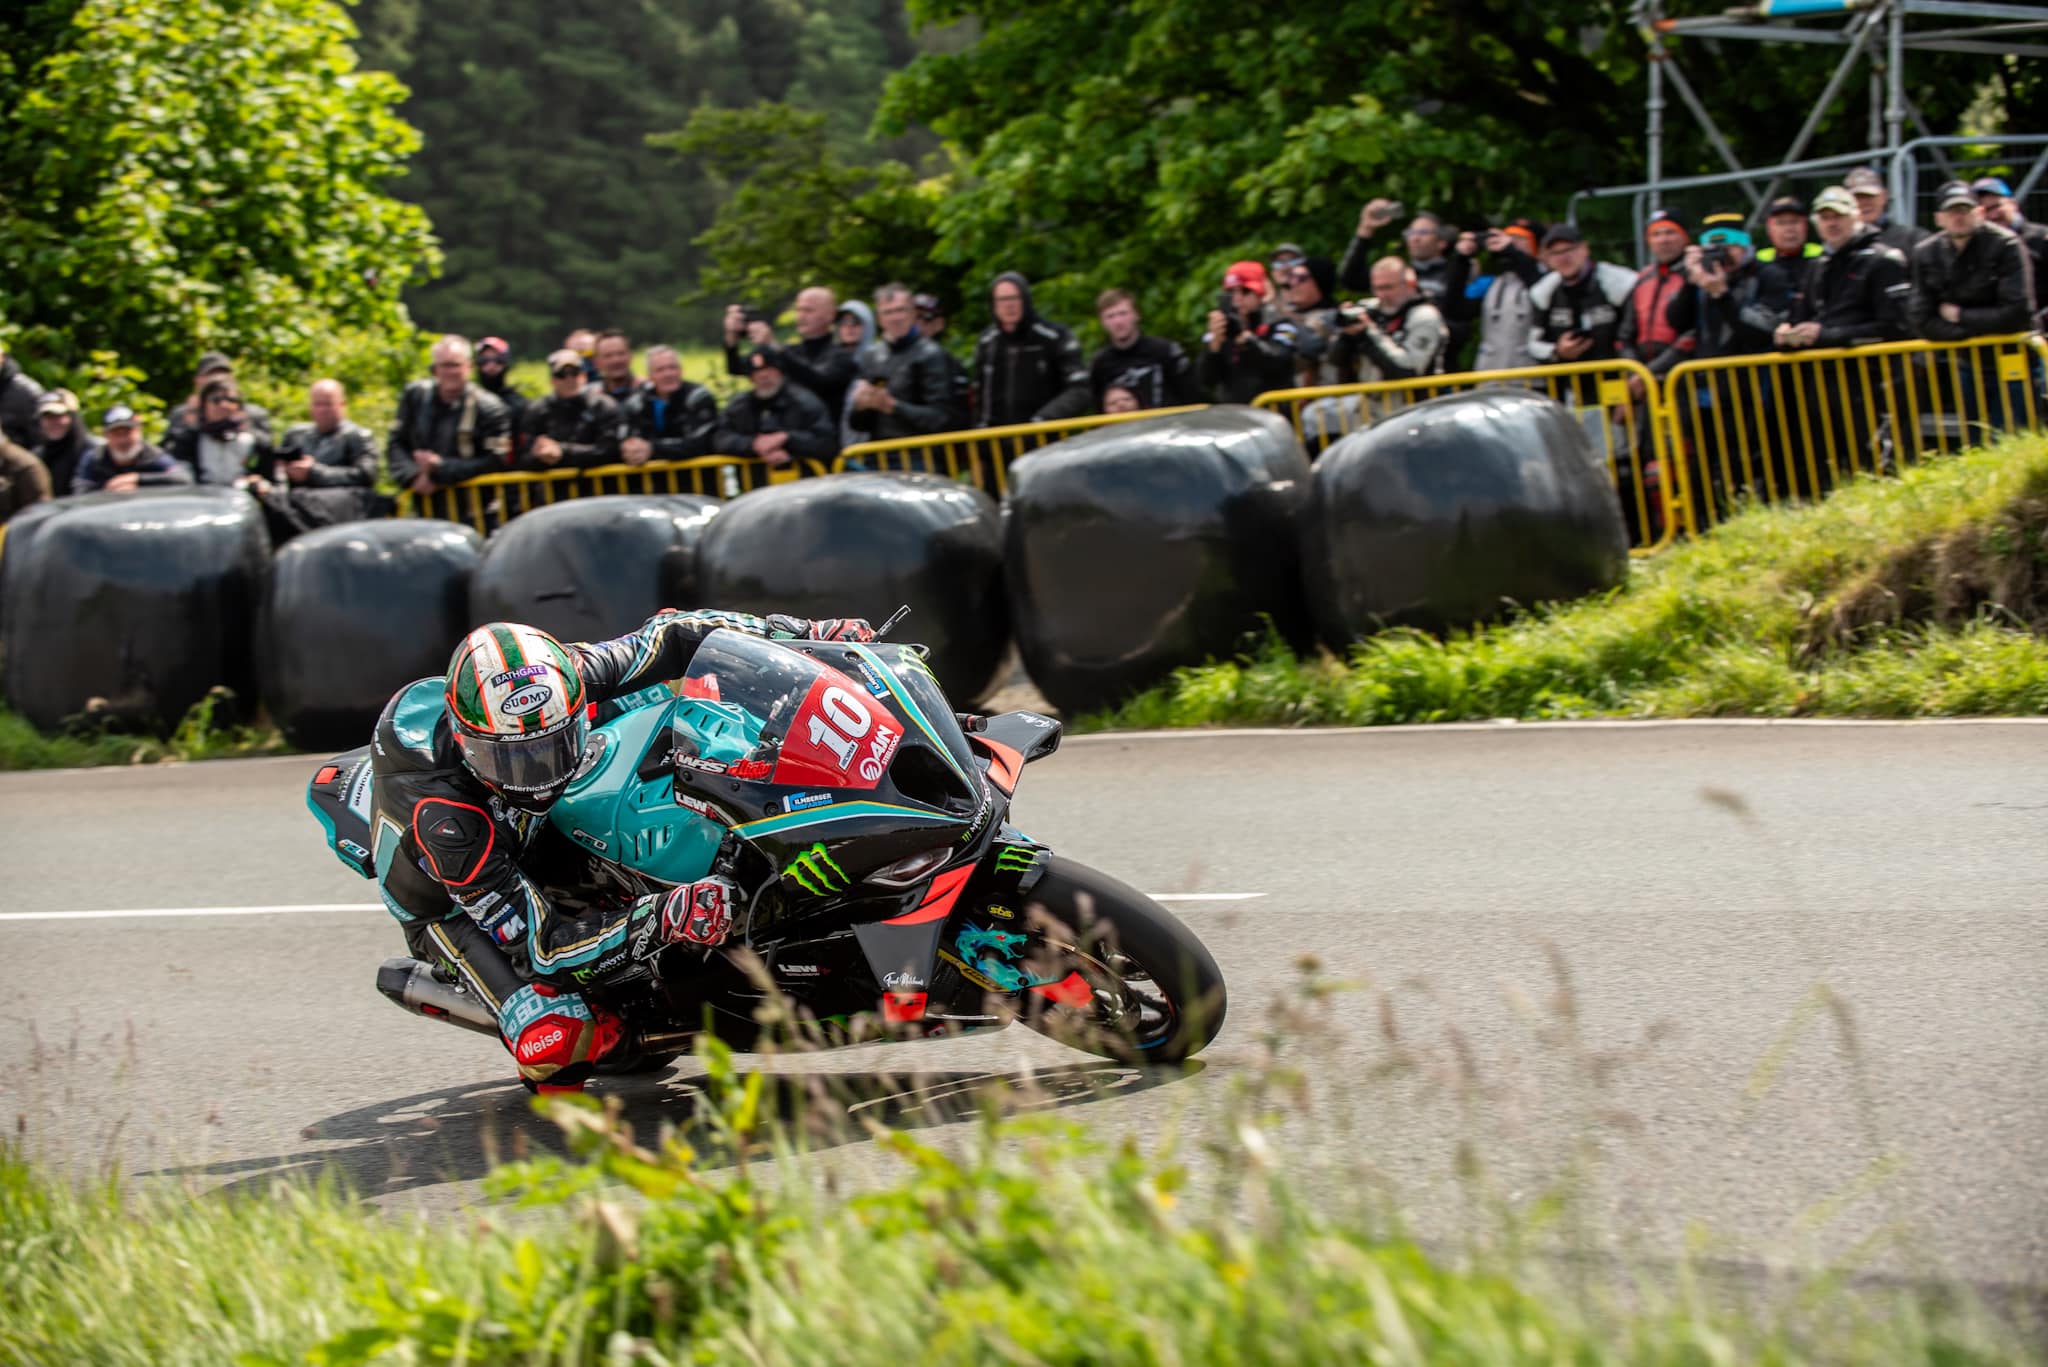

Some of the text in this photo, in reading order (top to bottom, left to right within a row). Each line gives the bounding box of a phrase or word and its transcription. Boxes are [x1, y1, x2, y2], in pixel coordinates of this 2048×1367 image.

[495, 666, 545, 684] BATHGATE
[504, 690, 549, 710] SUOMY
[807, 686, 872, 770] 10
[502, 767, 576, 793] peterhickman.net
[520, 1029, 563, 1059] Weise
